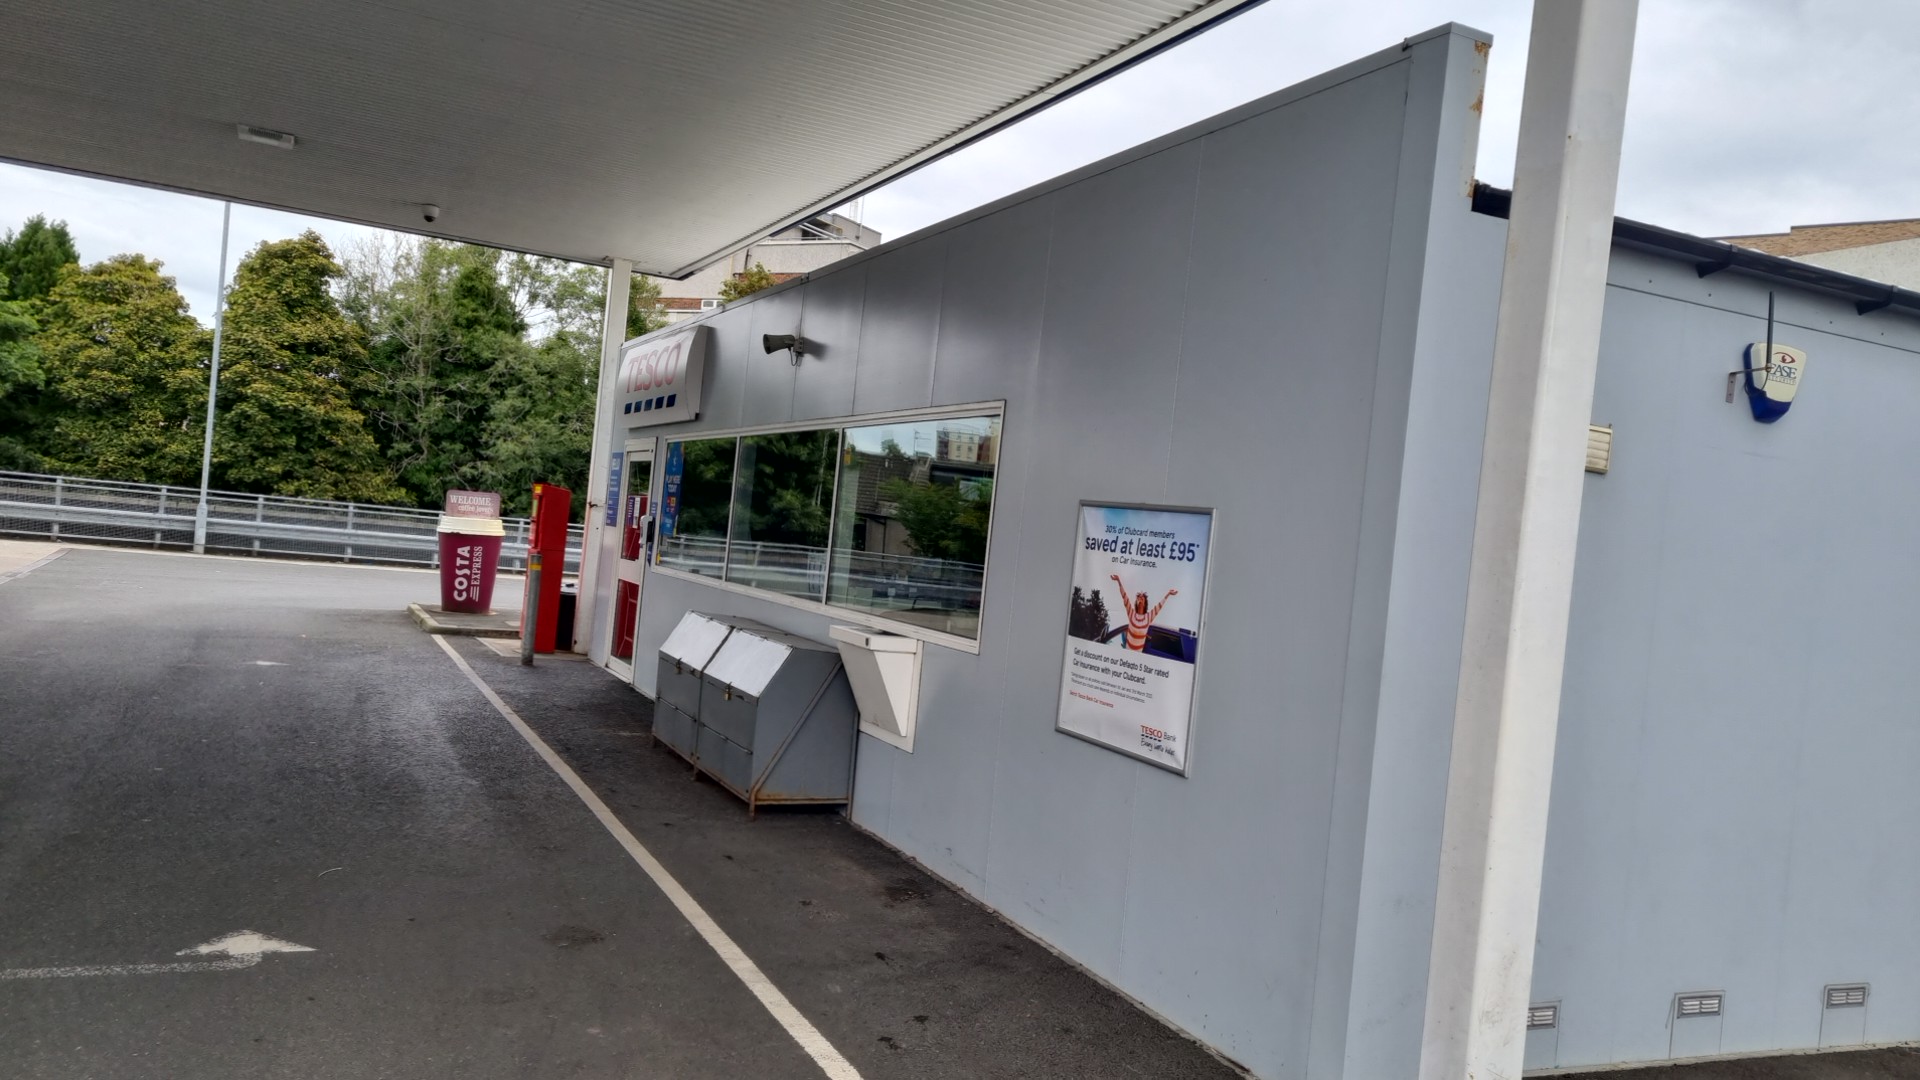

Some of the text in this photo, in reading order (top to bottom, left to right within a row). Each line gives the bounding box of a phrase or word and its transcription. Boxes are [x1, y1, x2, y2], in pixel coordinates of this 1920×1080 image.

[626, 340, 682, 394] TESCO
[450, 494, 491, 506] WELCOME
[458, 504, 475, 512] coffee
[1105, 525, 1175, 540] 30% of Clubcard members
[1085, 536, 1119, 553] saved
[1120, 538, 1134, 555] at
[1136, 538, 1167, 559] least
[471, 546, 483, 585] EXPRESS
[1119, 556, 1129, 565] Car
[453, 545, 471, 602] COSTA
[1084, 650, 1102, 661] discount
[1120, 659, 1138, 671] Defaqto
[1143, 664, 1154, 674] Star
[1154, 669, 1169, 678] rated
[1101, 666, 1111, 675] with
[1111, 670, 1122, 678] your
[1140, 725, 1176, 742] TESCO Bank
